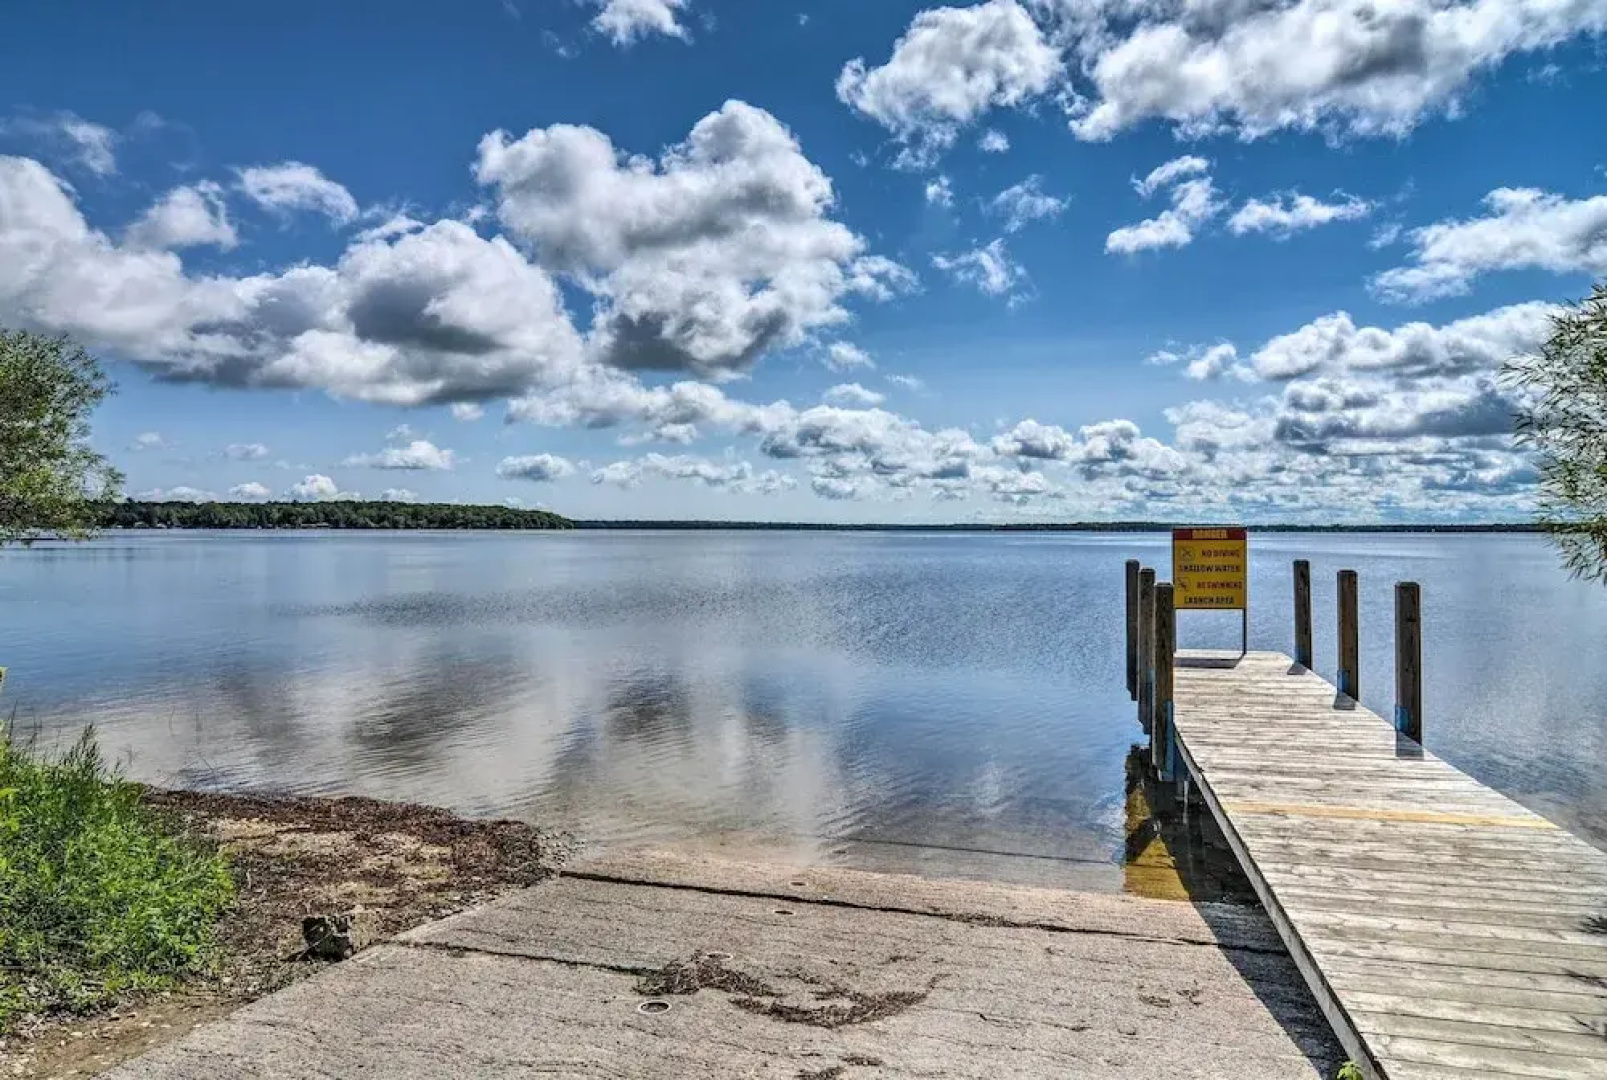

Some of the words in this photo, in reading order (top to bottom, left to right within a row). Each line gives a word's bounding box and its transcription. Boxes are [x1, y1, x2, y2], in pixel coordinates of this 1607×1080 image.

[1201, 549, 1212, 557] NO
[1213, 549, 1240, 557] DIVING
[1178, 564, 1213, 572] SHALLOW
[1214, 564, 1240, 572] WATER
[1184, 596, 1214, 604] LAUNCH
[1215, 596, 1235, 604] AREA
